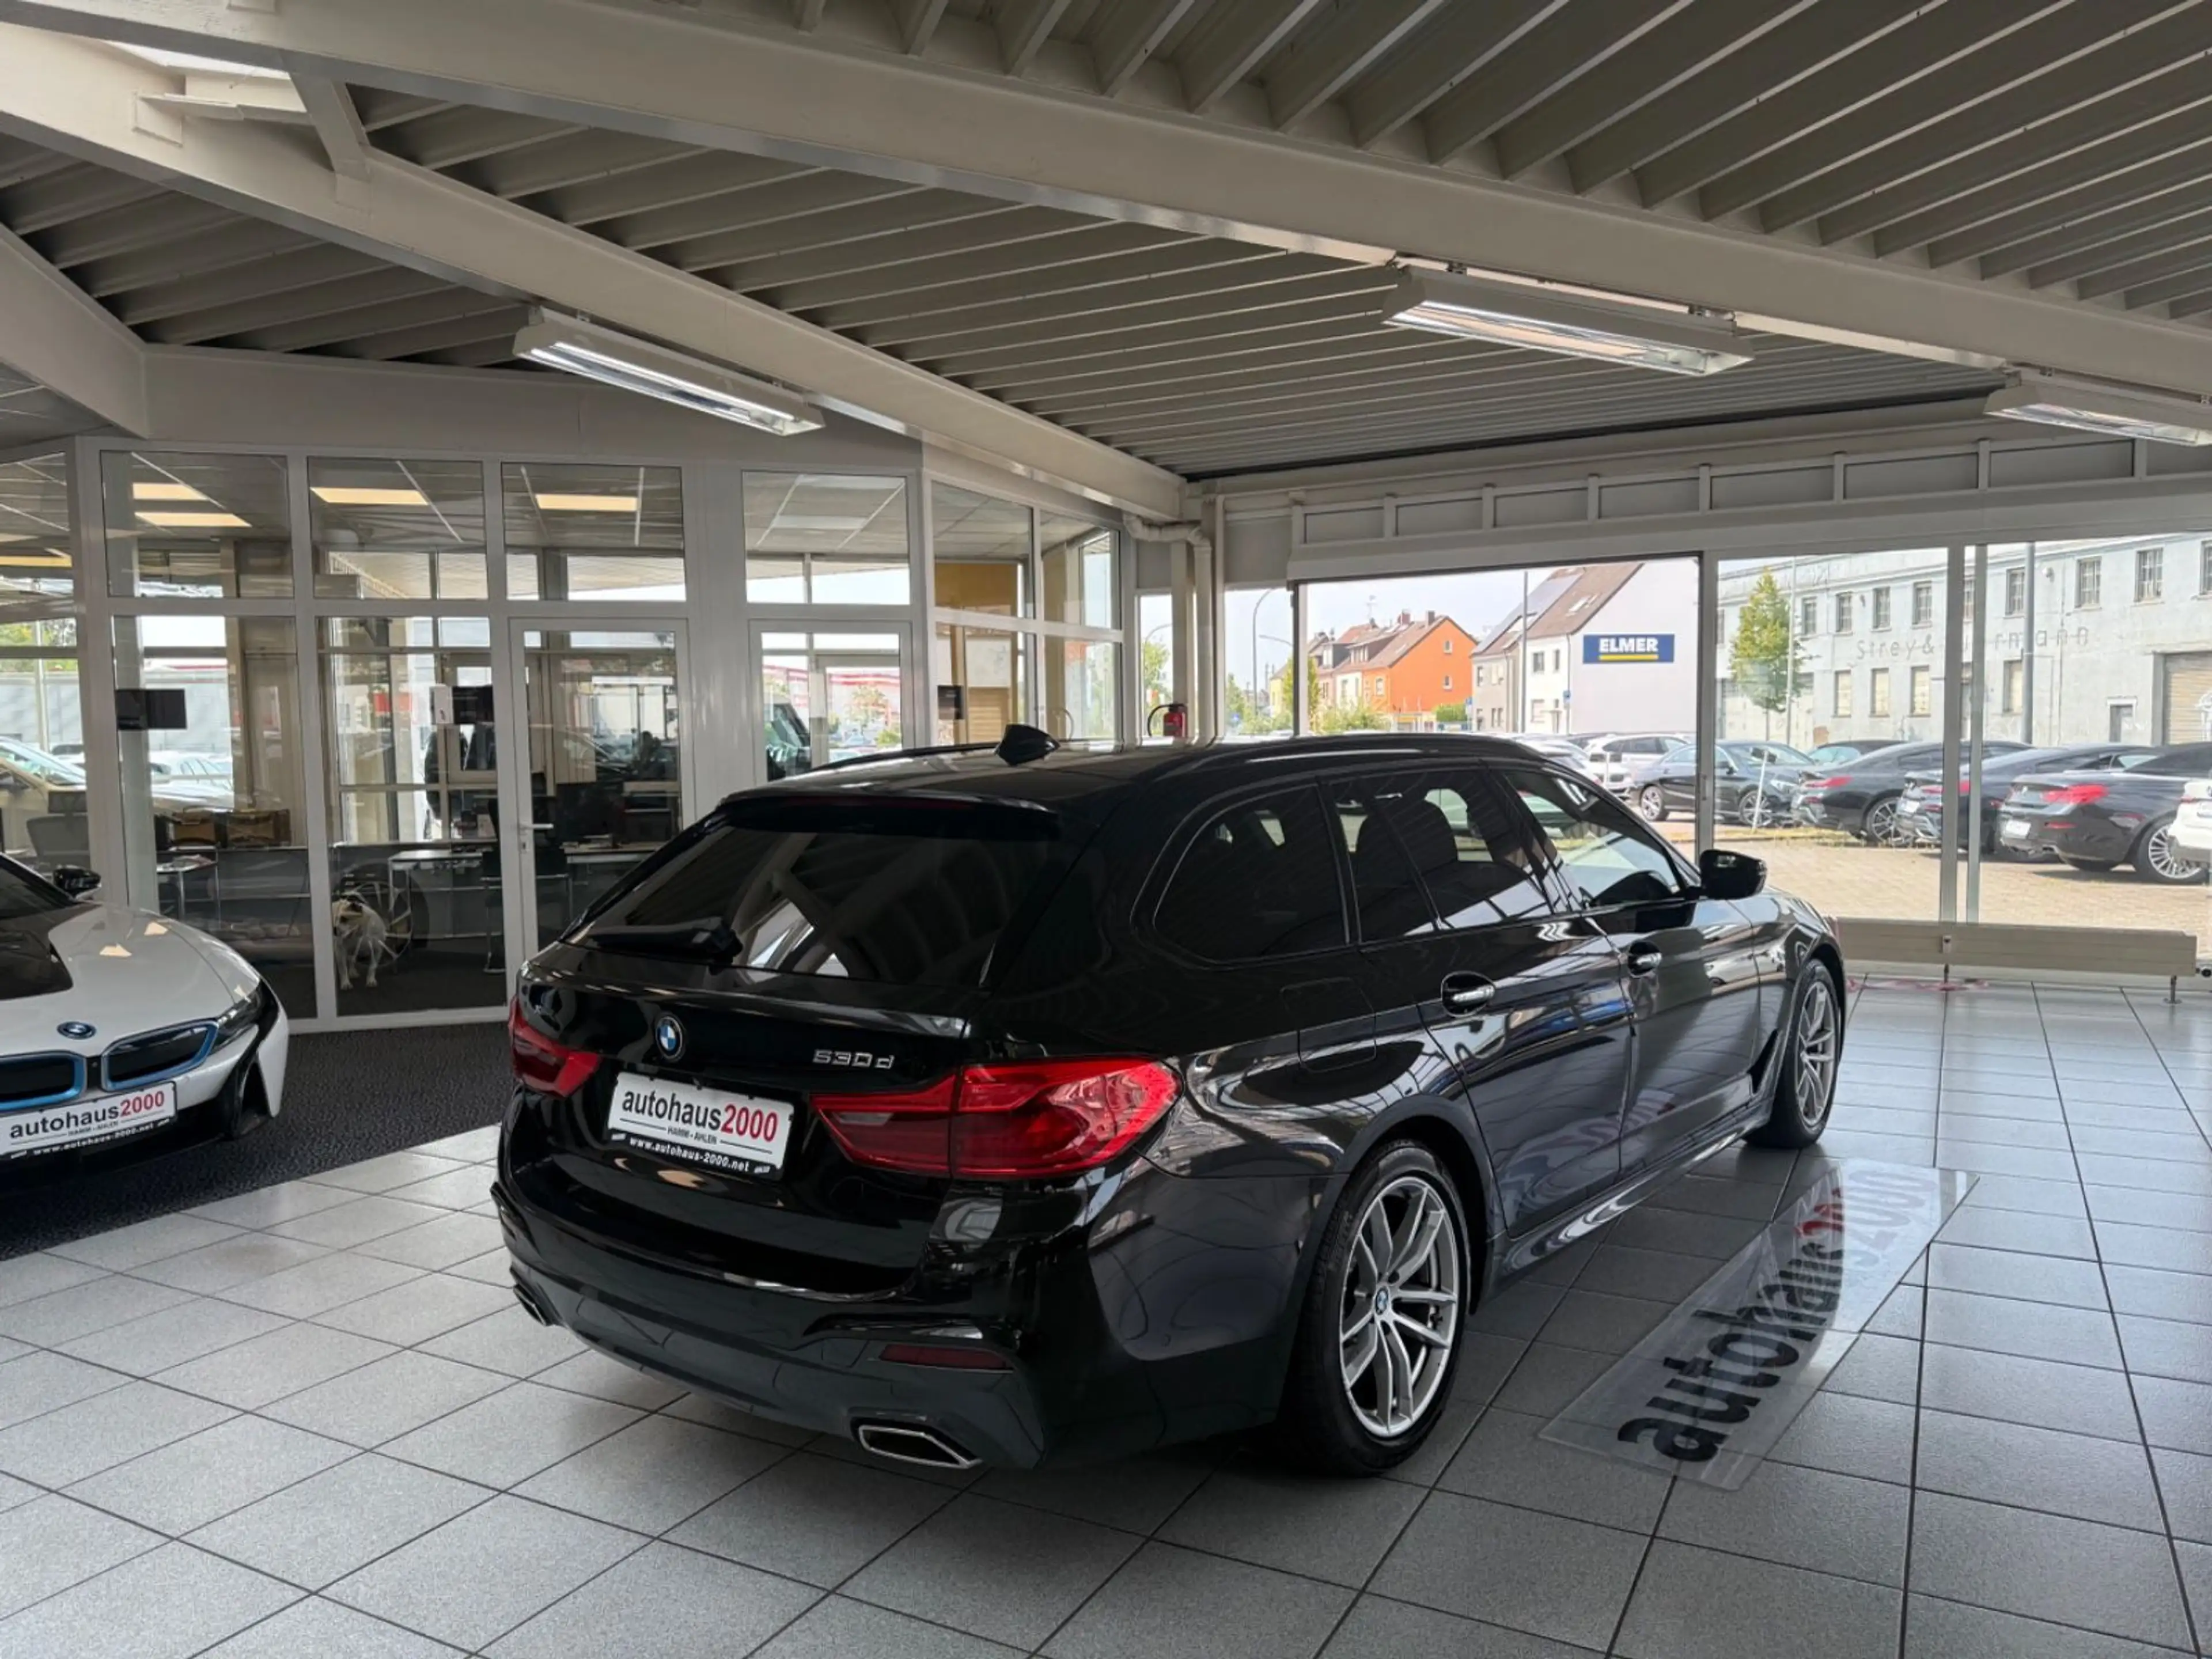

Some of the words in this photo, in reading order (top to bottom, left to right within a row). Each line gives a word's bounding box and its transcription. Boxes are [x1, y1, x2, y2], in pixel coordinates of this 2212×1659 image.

[1599, 637, 1658, 653] ELMER
[10, 1090, 165, 1139] autohaus2000
[622, 1090, 778, 1143] autohaus2000
[630, 1137, 749, 1172] www.autohaus-2000.net
